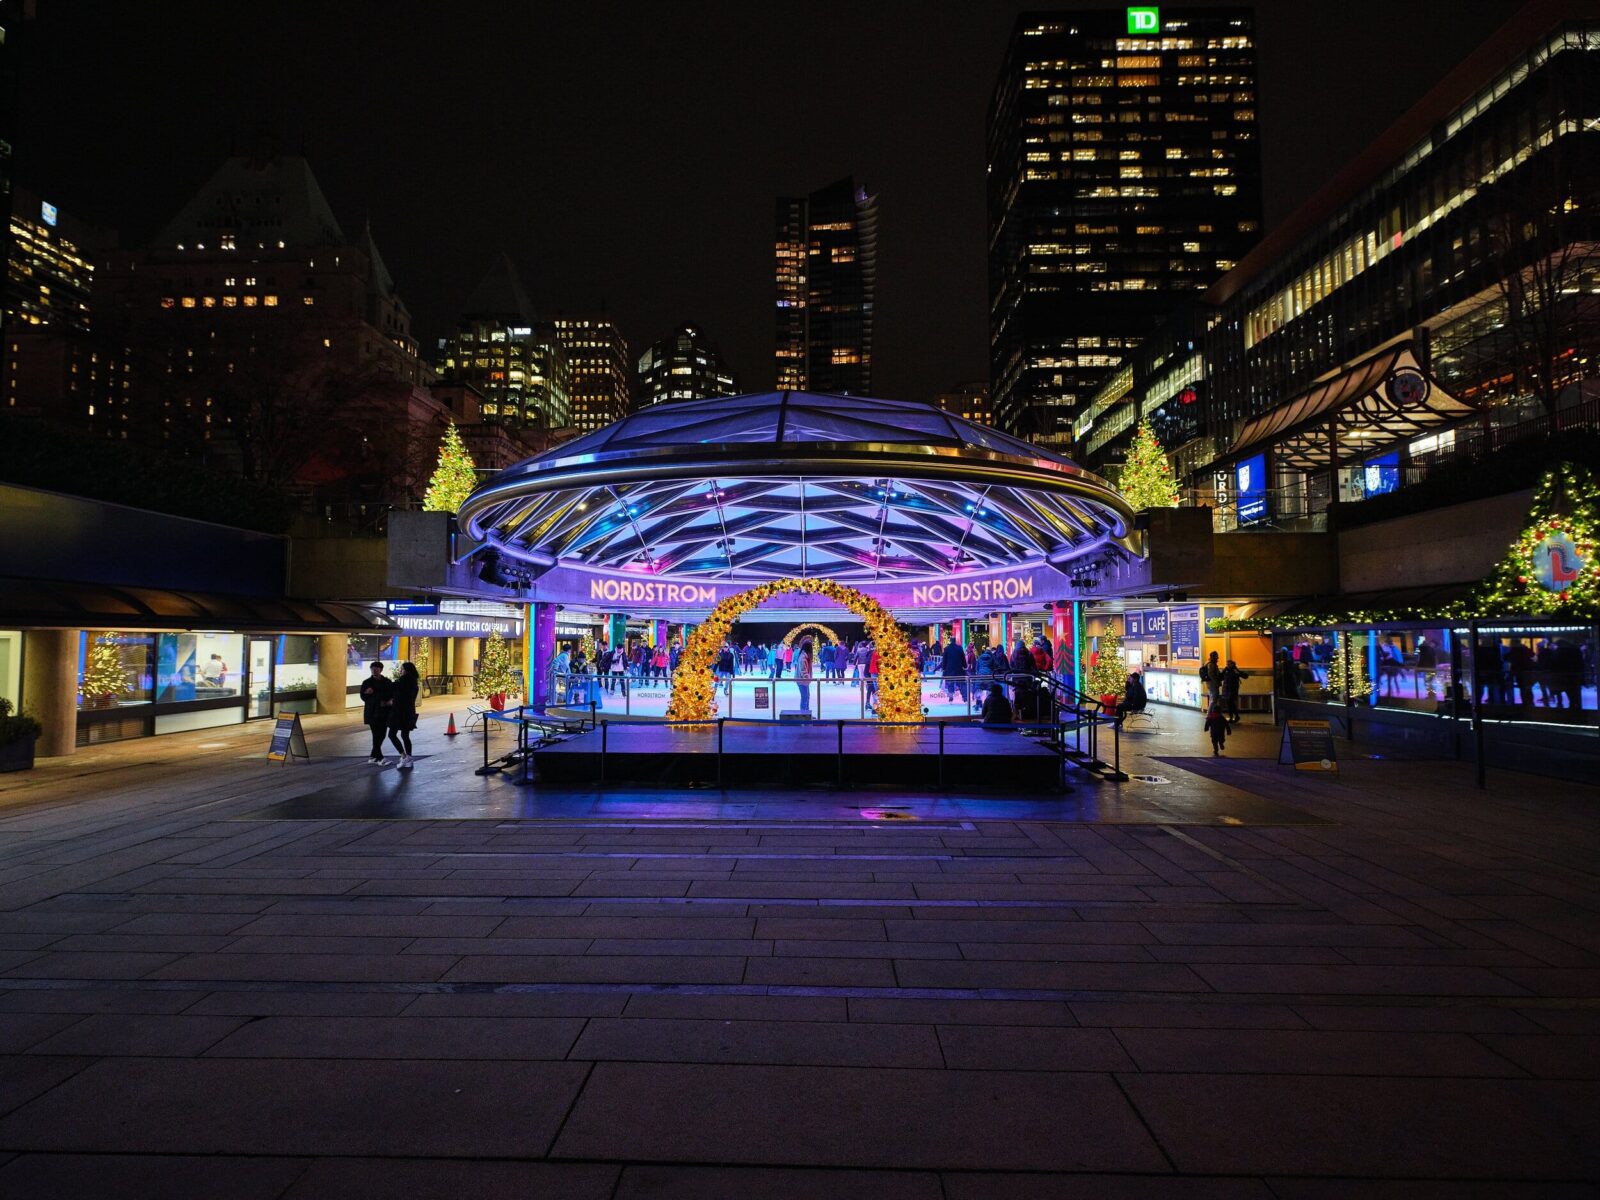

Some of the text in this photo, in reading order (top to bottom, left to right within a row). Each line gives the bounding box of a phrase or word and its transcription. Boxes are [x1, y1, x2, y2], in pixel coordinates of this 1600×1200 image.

[1130, 11, 1157, 30] TD
[590, 579, 717, 603] NORDSTROM
[913, 576, 1033, 604] NORDSTROM
[397, 617, 444, 631] UNIVERSITY
[444, 619, 455, 631] OF
[455, 620, 480, 632] BRITISH
[1148, 613, 1166, 631] CAFÉ
